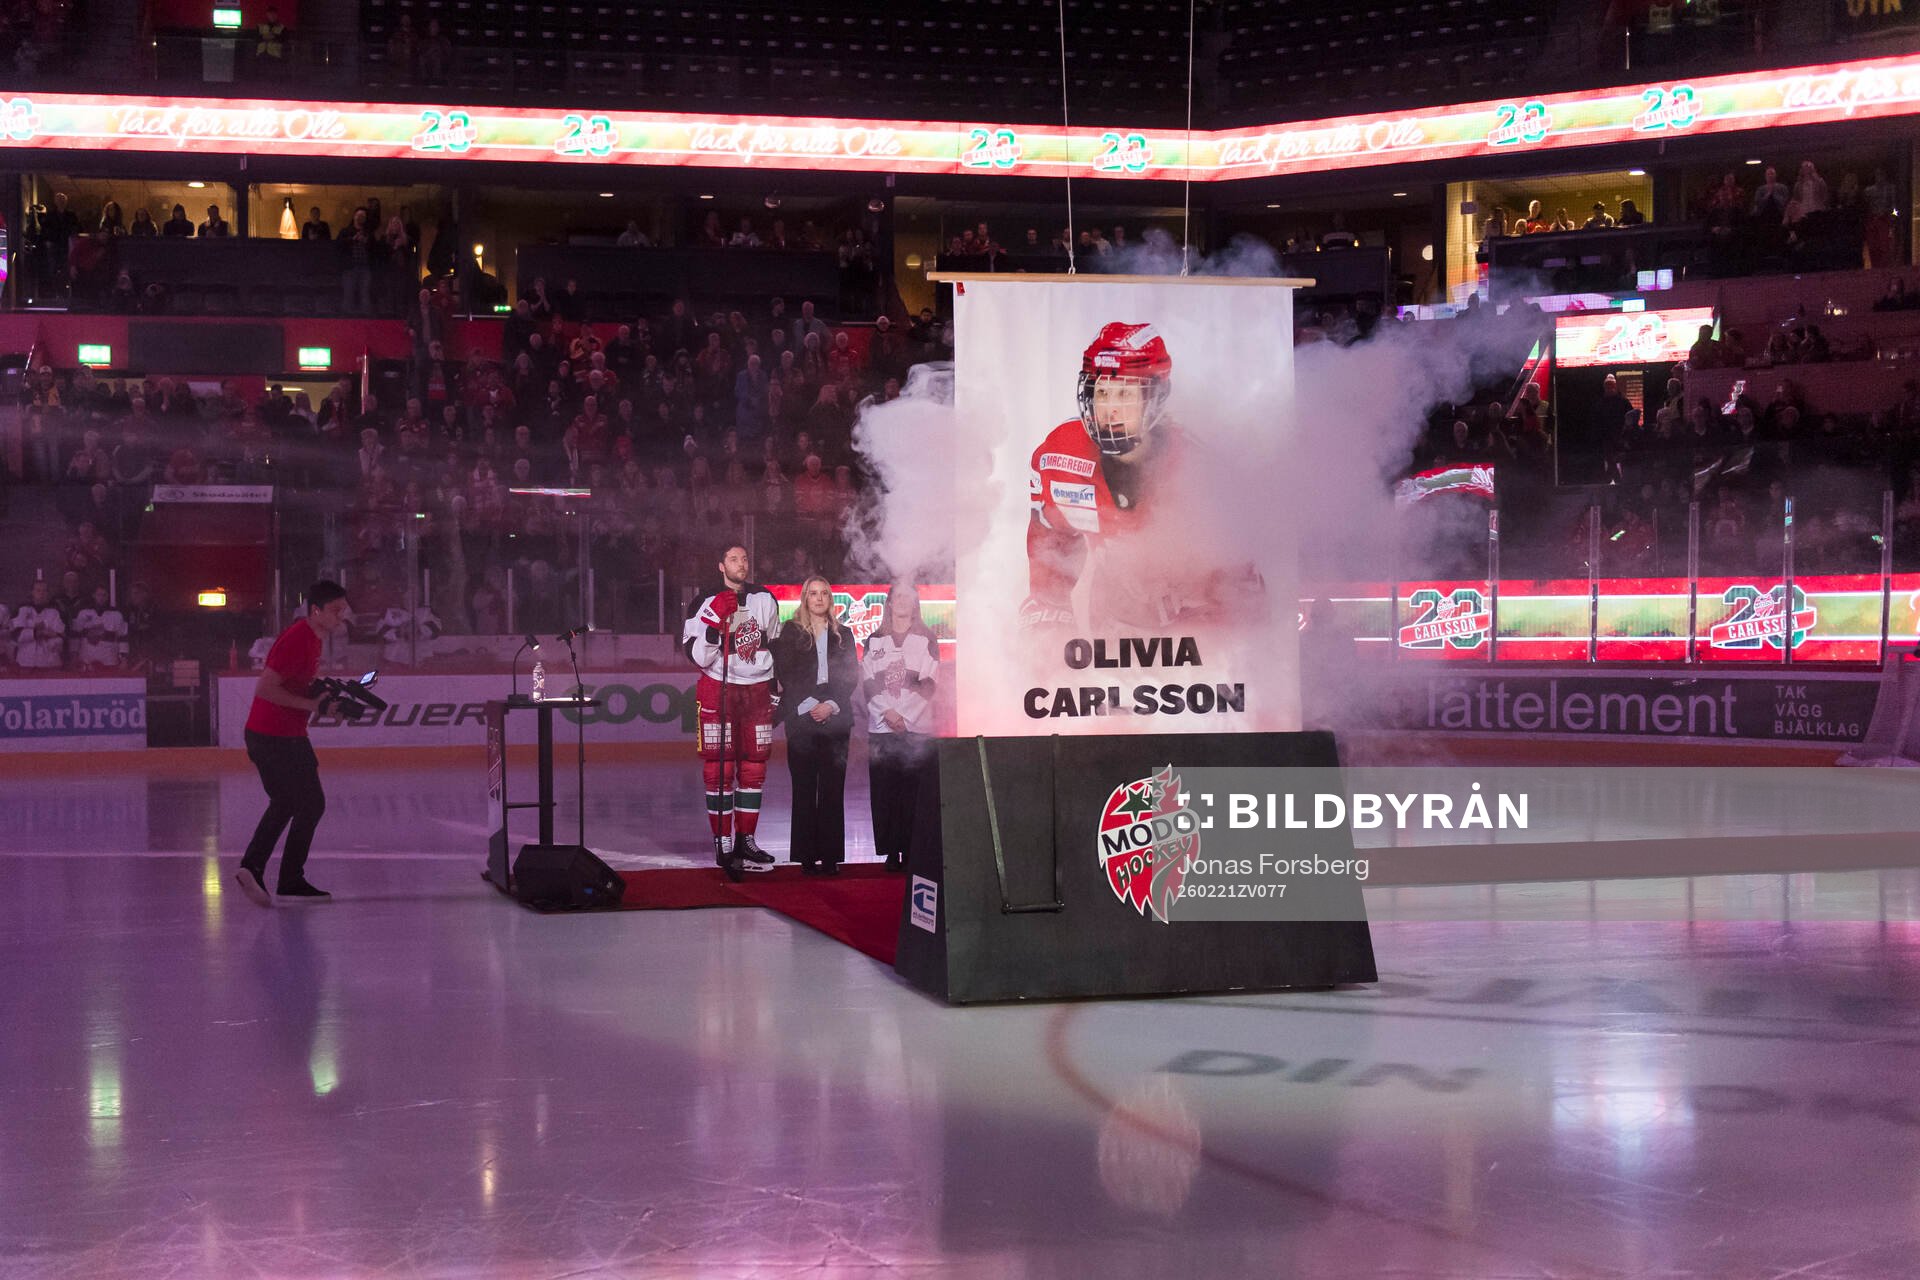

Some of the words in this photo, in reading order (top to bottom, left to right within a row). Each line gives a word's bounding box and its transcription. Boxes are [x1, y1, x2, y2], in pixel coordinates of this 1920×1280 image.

[112, 105, 177, 136] Tack
[284, 109, 346, 140] Olle
[688, 123, 745, 152] Tack
[843, 127, 902, 156] Olle
[1215, 133, 1272, 165] Tack
[1366, 118, 1424, 151] Olle
[1046, 455, 1093, 474] MACGREGOR
[1409, 588, 1484, 649] 23
[1414, 617, 1477, 640] CARLSSON
[736, 631, 760, 646] MODO
[1064, 637, 1203, 669] OLIVIA
[1024, 683, 1245, 718] CARLSSON
[1776, 686, 1807, 699] TAK
[0, 699, 146, 730] olarbröd
[1776, 702, 1822, 718] VÄGG
[1774, 718, 1860, 737] BJÄLKLAG
[1101, 811, 1196, 855] MODO
[1115, 836, 1193, 889] HOCKEY
